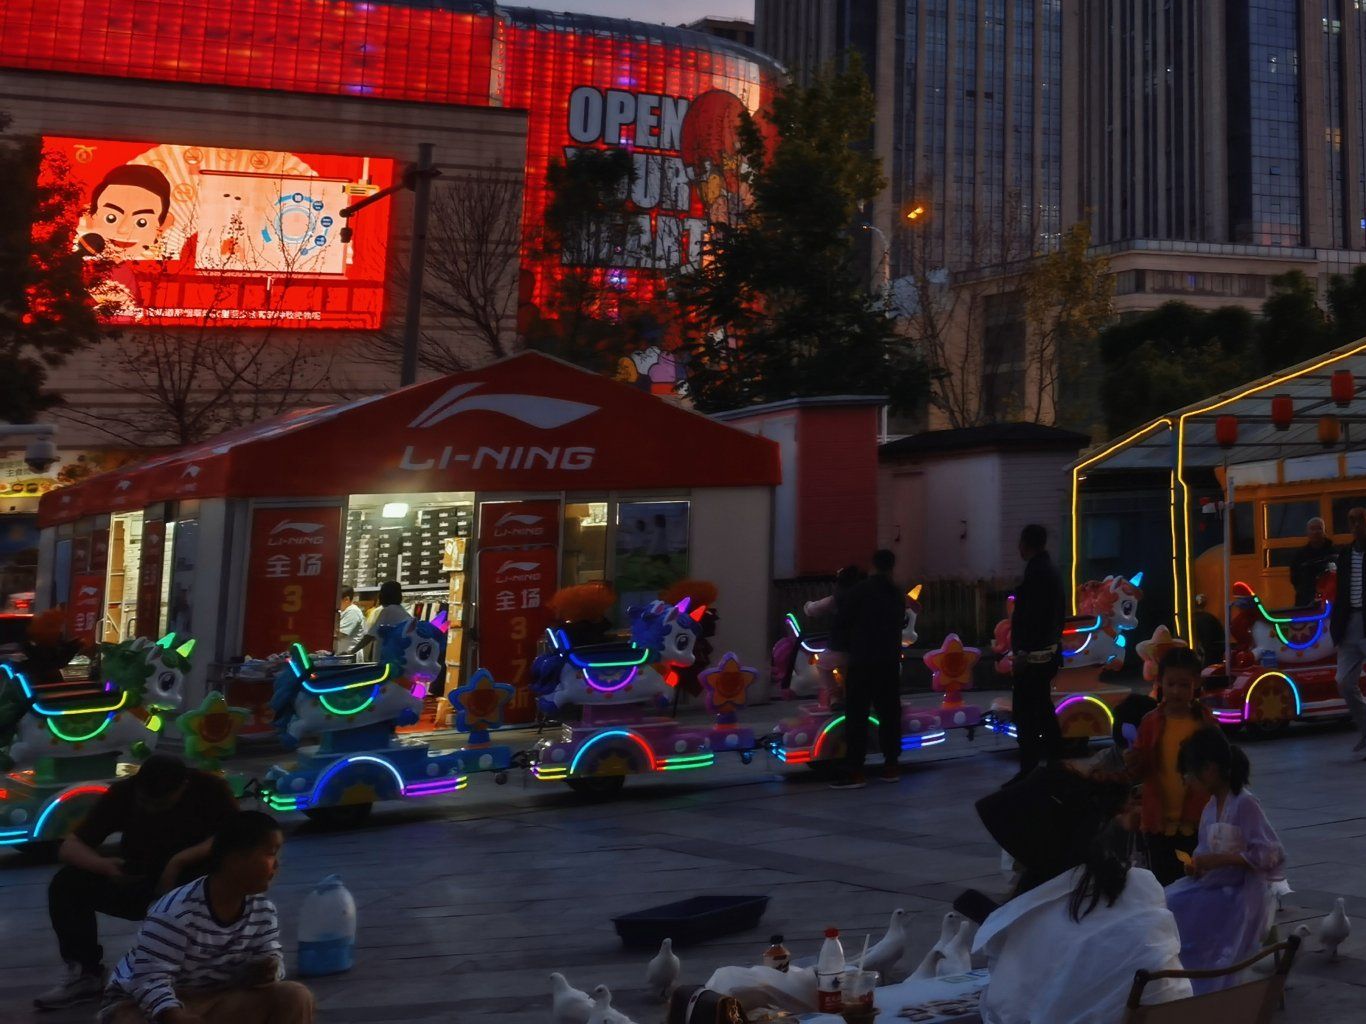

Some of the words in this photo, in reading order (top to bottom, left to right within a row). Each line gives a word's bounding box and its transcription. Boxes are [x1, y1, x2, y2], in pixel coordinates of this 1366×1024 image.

[568, 86, 690, 151] OPEN
[565, 147, 692, 212] UR
[562, 212, 708, 273] ART
[399, 445, 595, 470] LI-NING
[267, 535, 325, 546] LI-NING
[494, 527, 544, 537] LI-NING
[265, 553, 323, 578] 全场
[496, 573, 541, 584] LI-NING
[495, 587, 541, 612] 全场
